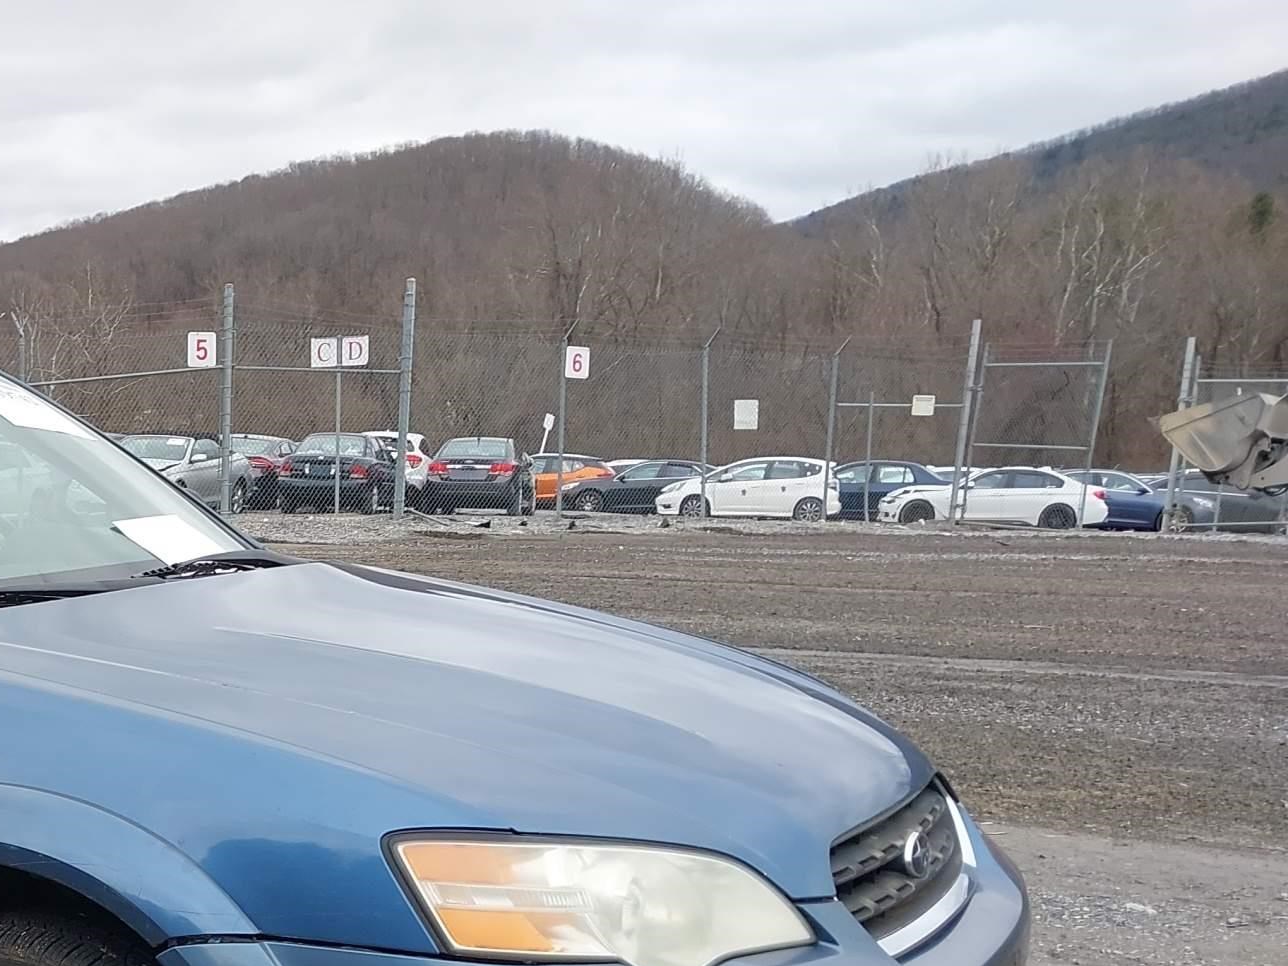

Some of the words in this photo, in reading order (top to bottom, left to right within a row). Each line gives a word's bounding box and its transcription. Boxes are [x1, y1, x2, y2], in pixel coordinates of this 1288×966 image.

[196, 338, 208, 361] 5
[317, 342, 331, 362] C
[348, 341, 362, 361] D
[572, 353, 583, 373] 6
